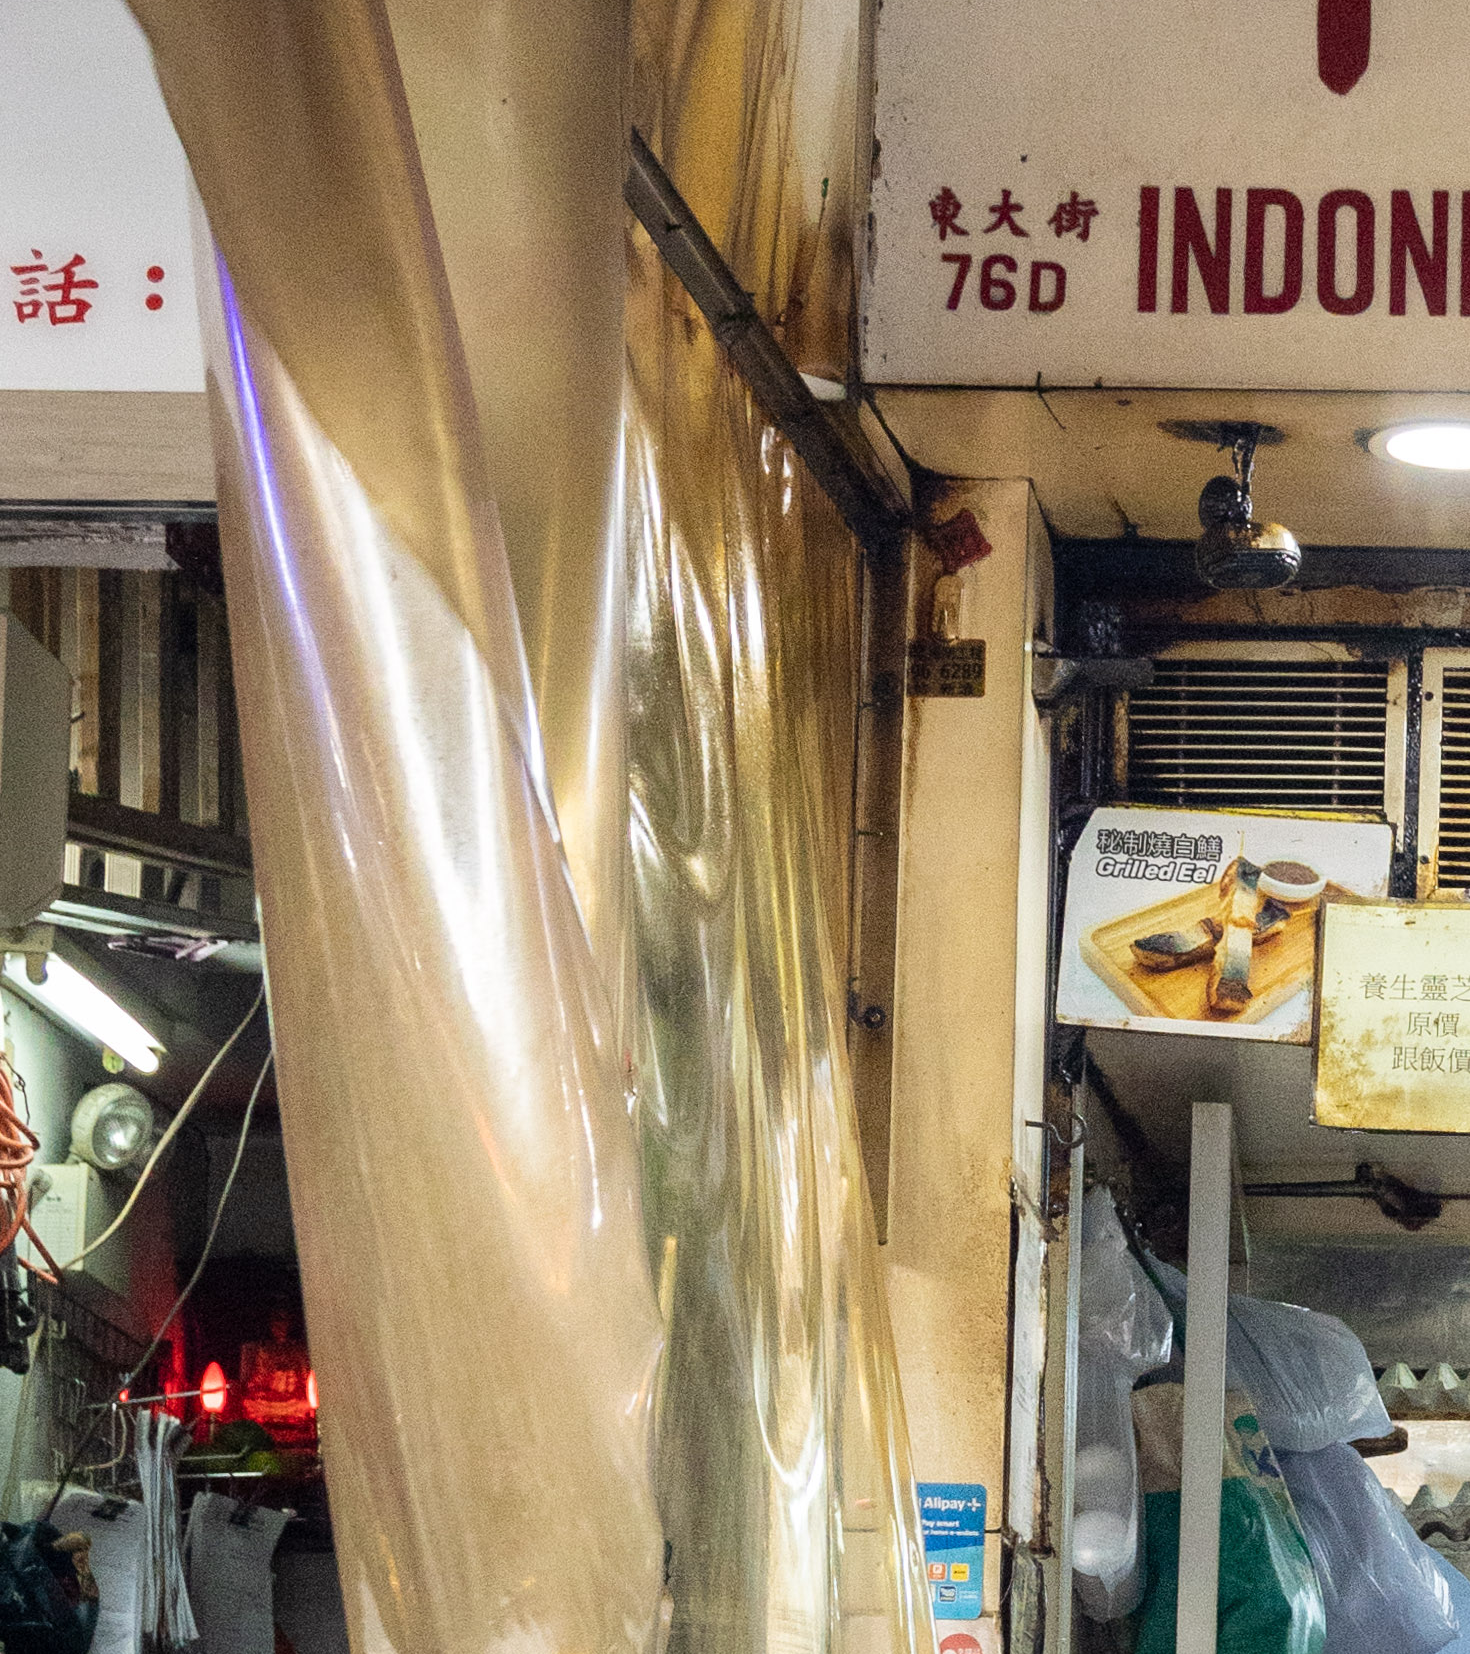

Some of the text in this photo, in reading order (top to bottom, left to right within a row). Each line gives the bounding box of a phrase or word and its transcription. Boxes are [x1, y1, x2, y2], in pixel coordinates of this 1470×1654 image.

[926, 185, 1100, 245] 東大街
[942, 252, 1067, 313] 76D
[1096, 858, 1216, 884] Grilled Eel
